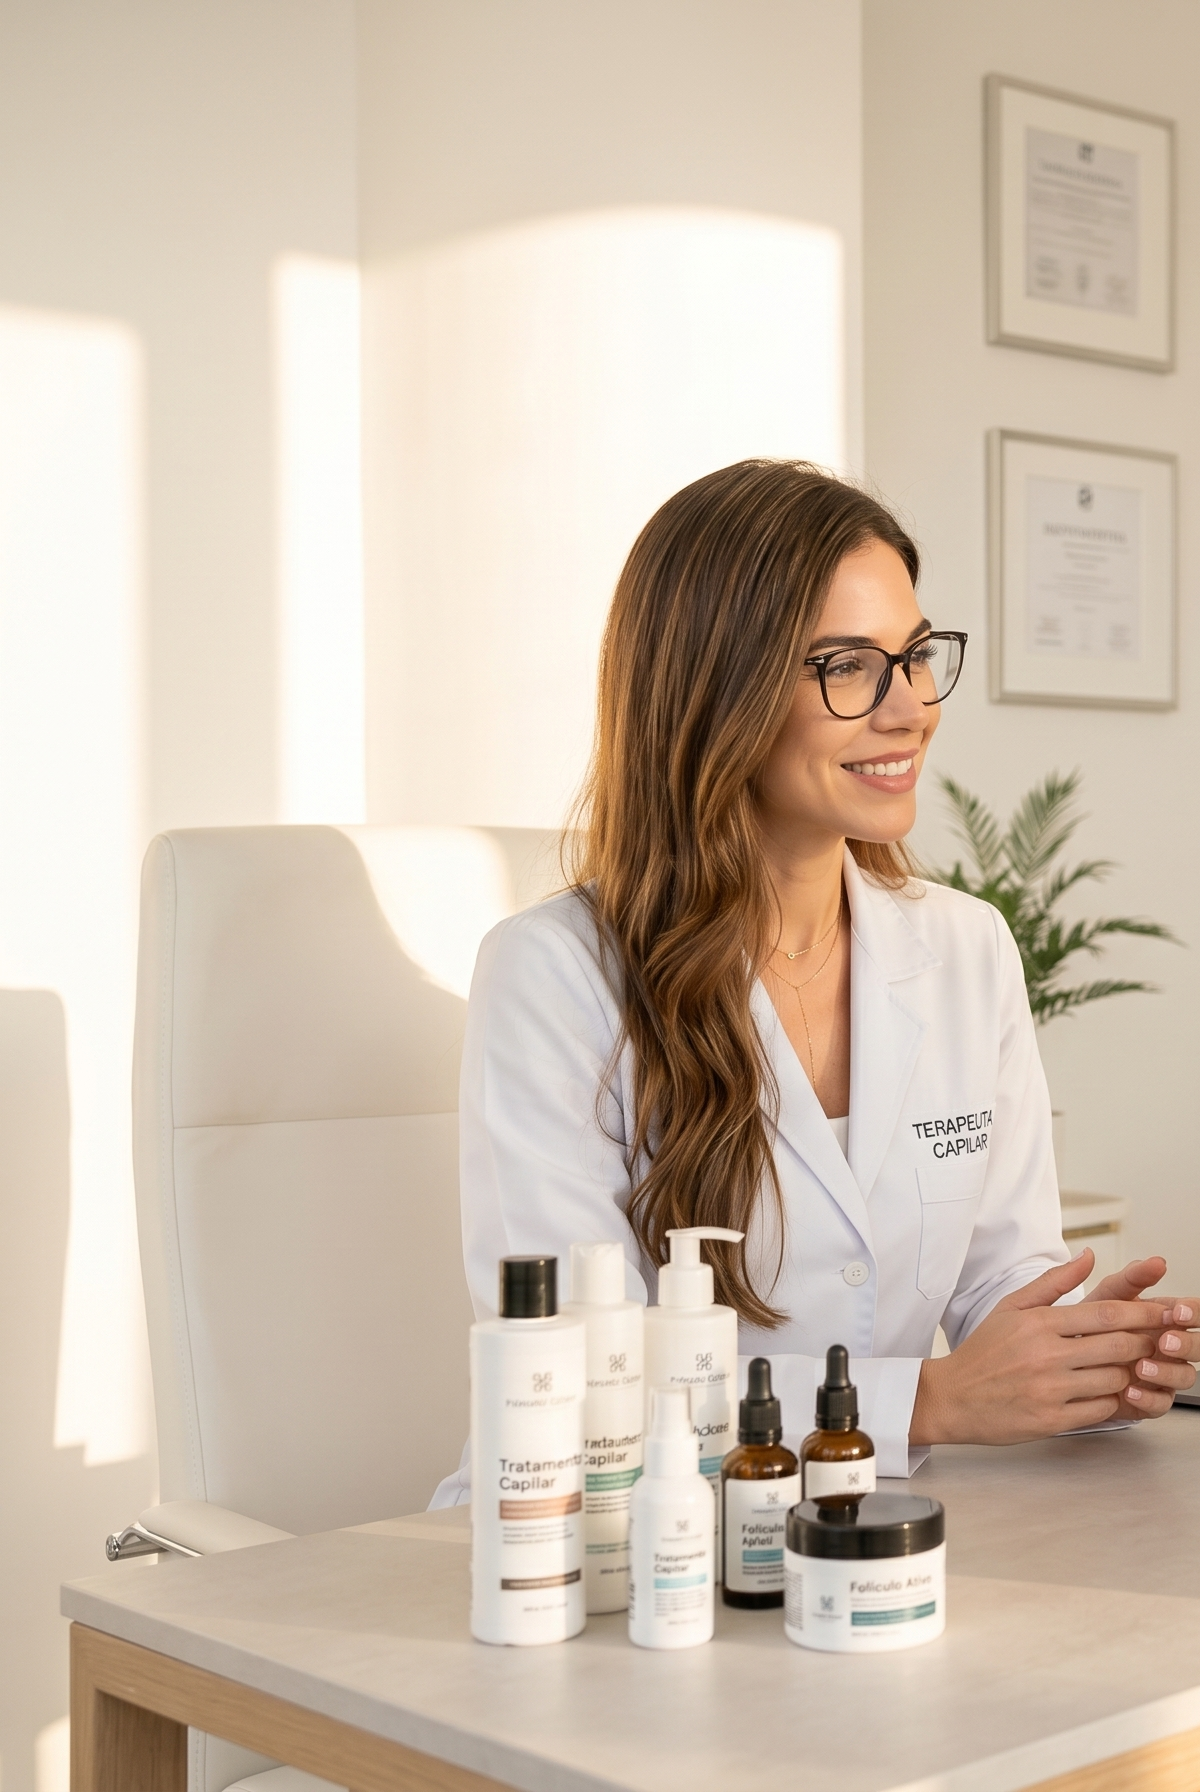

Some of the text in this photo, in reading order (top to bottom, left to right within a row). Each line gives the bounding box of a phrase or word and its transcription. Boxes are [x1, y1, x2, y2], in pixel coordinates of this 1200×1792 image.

[912, 1109, 993, 1139] TERAPEUTA
[933, 1133, 988, 1159] CAPILAR
[499, 1476, 556, 1493] Capilar
